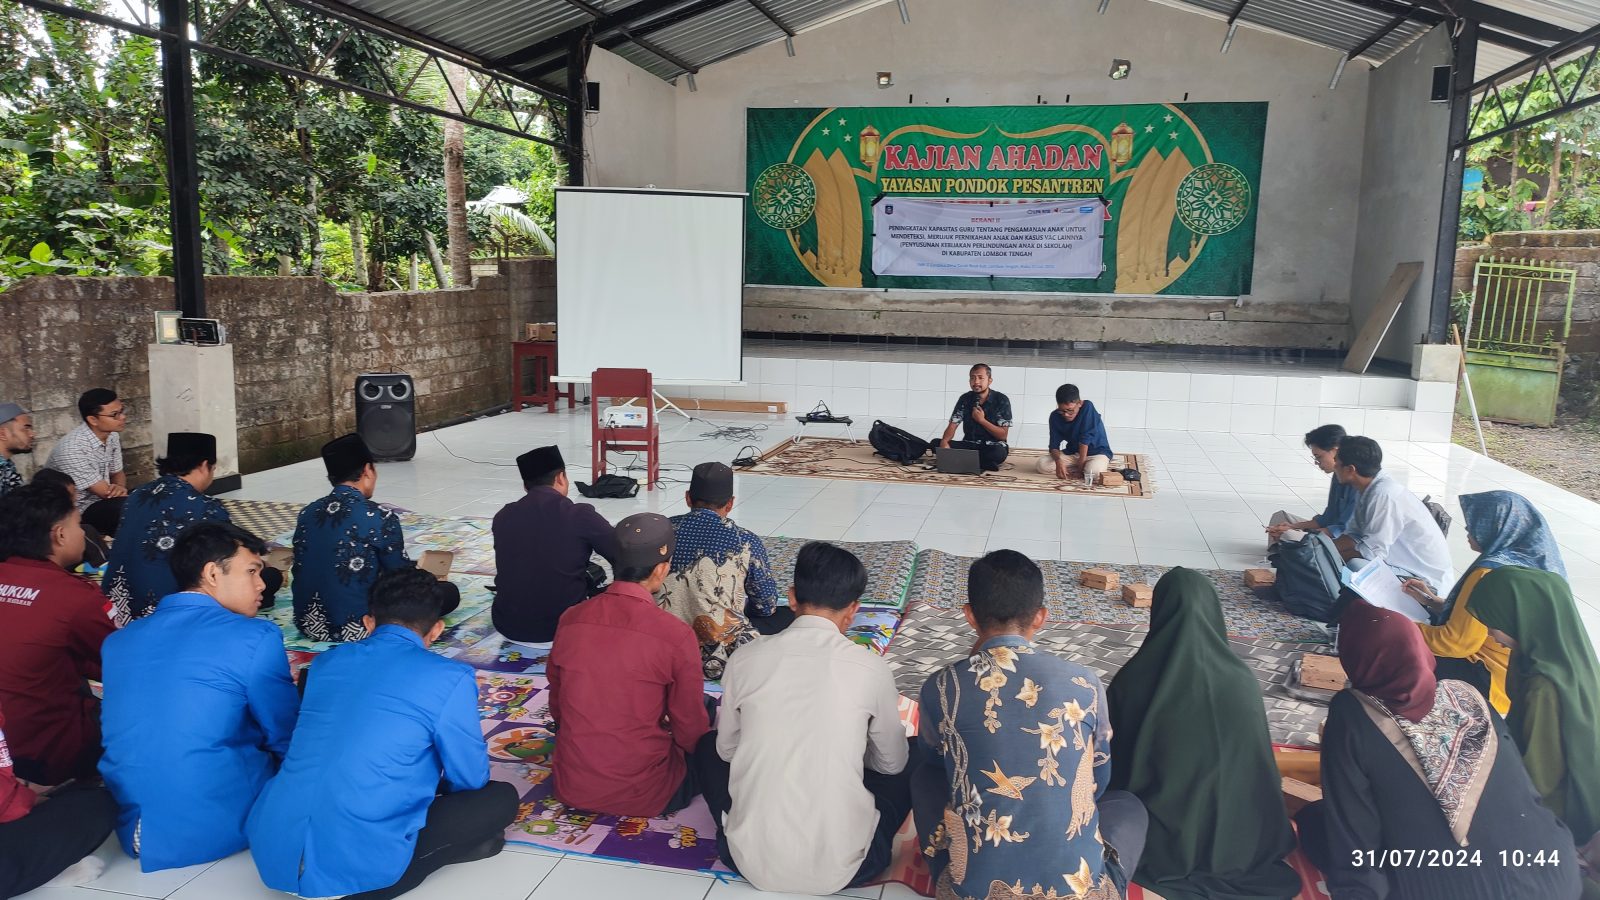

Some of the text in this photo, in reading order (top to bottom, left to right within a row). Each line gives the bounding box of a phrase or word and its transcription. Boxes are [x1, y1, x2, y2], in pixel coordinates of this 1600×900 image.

[884, 144, 1104, 171] KAJIAN AHADAN
[880, 178, 1104, 194] YAYASAN PONDOK PESANTREN
[0, 583, 41, 601] HUKUM
